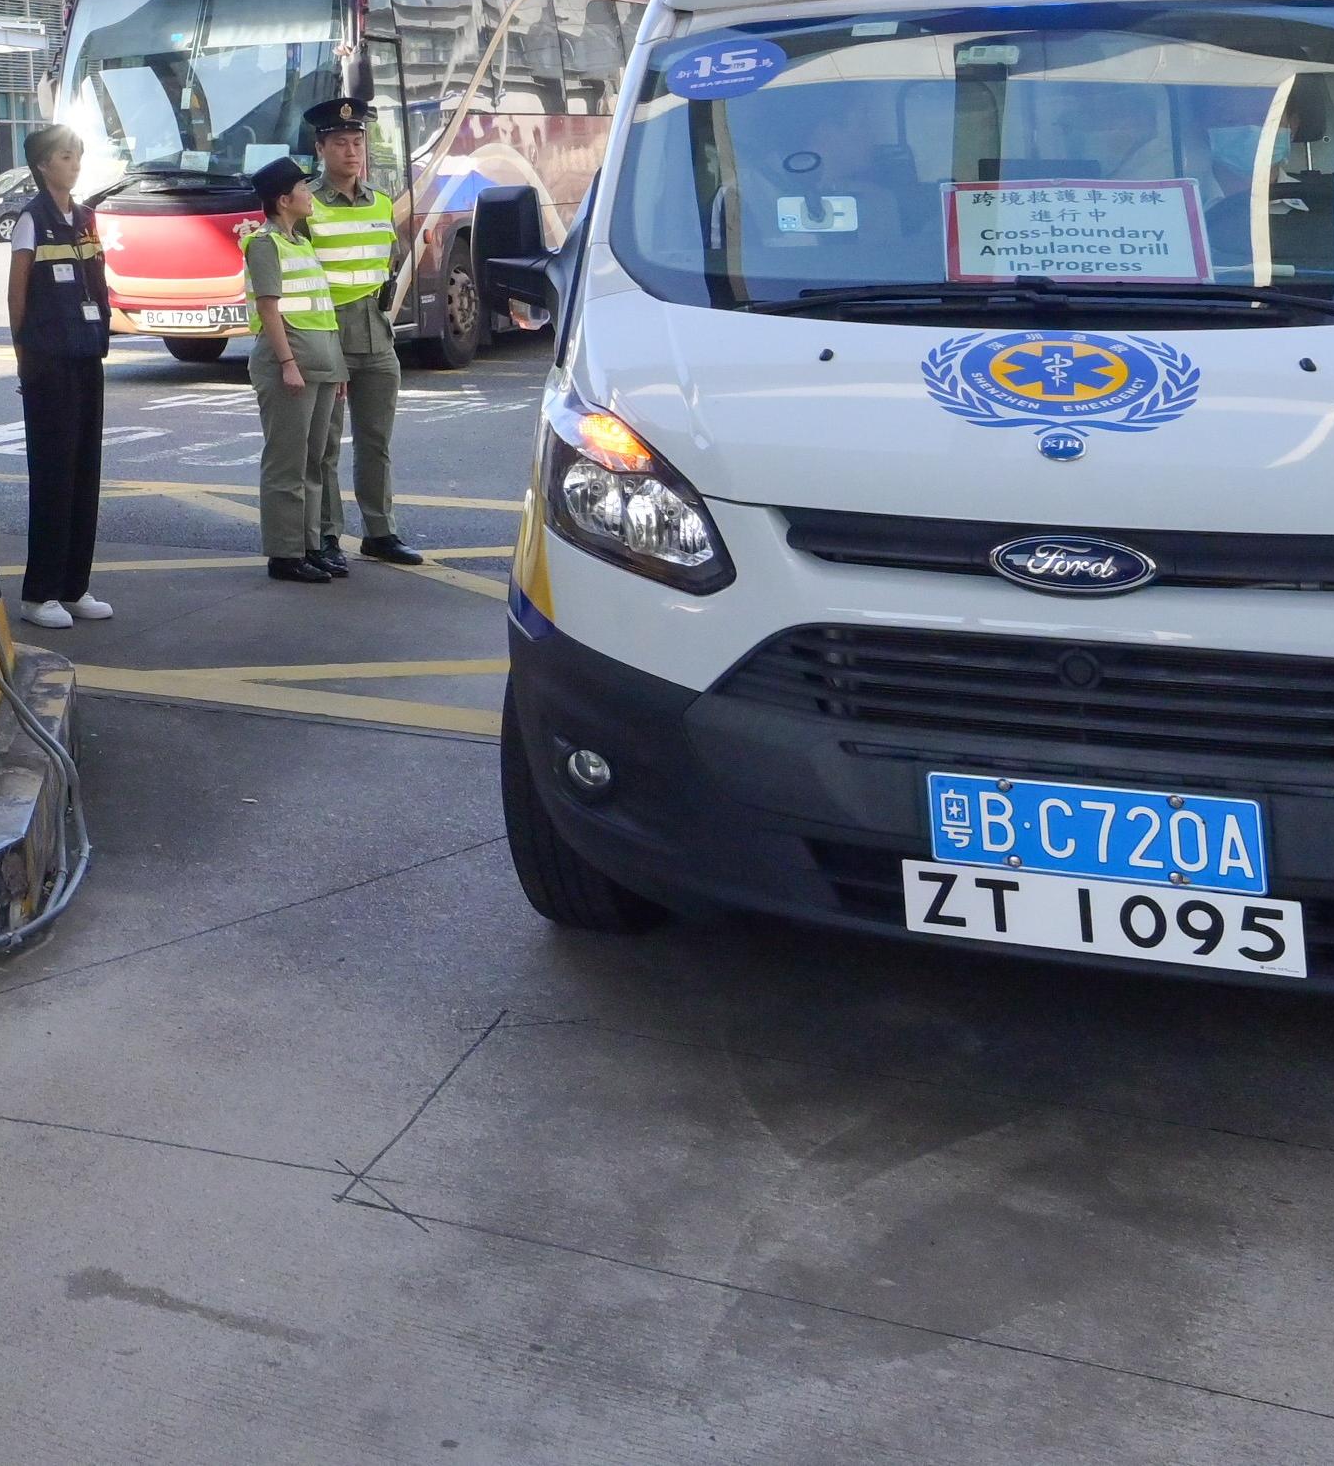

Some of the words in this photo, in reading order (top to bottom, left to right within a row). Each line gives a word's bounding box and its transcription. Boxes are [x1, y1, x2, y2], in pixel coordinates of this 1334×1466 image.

[972, 189, 1166, 207] 跨境救護車演練
[1030, 208, 1107, 223] 進行中
[980, 225, 1165, 242] Cross-boundary
[979, 242, 1112, 256] Ambulance
[1120, 242, 1169, 256] Drill
[1009, 259, 1143, 274] In-Progress
[170, 312, 204, 325] 1799
[971, 372, 1040, 410] SHENZHEN
[1062, 377, 1147, 413] EMERGENCY
[1026, 543, 1118, 578] Ford
[918, 870, 1020, 933] ZT
[1077, 887, 1286, 963] 1095
